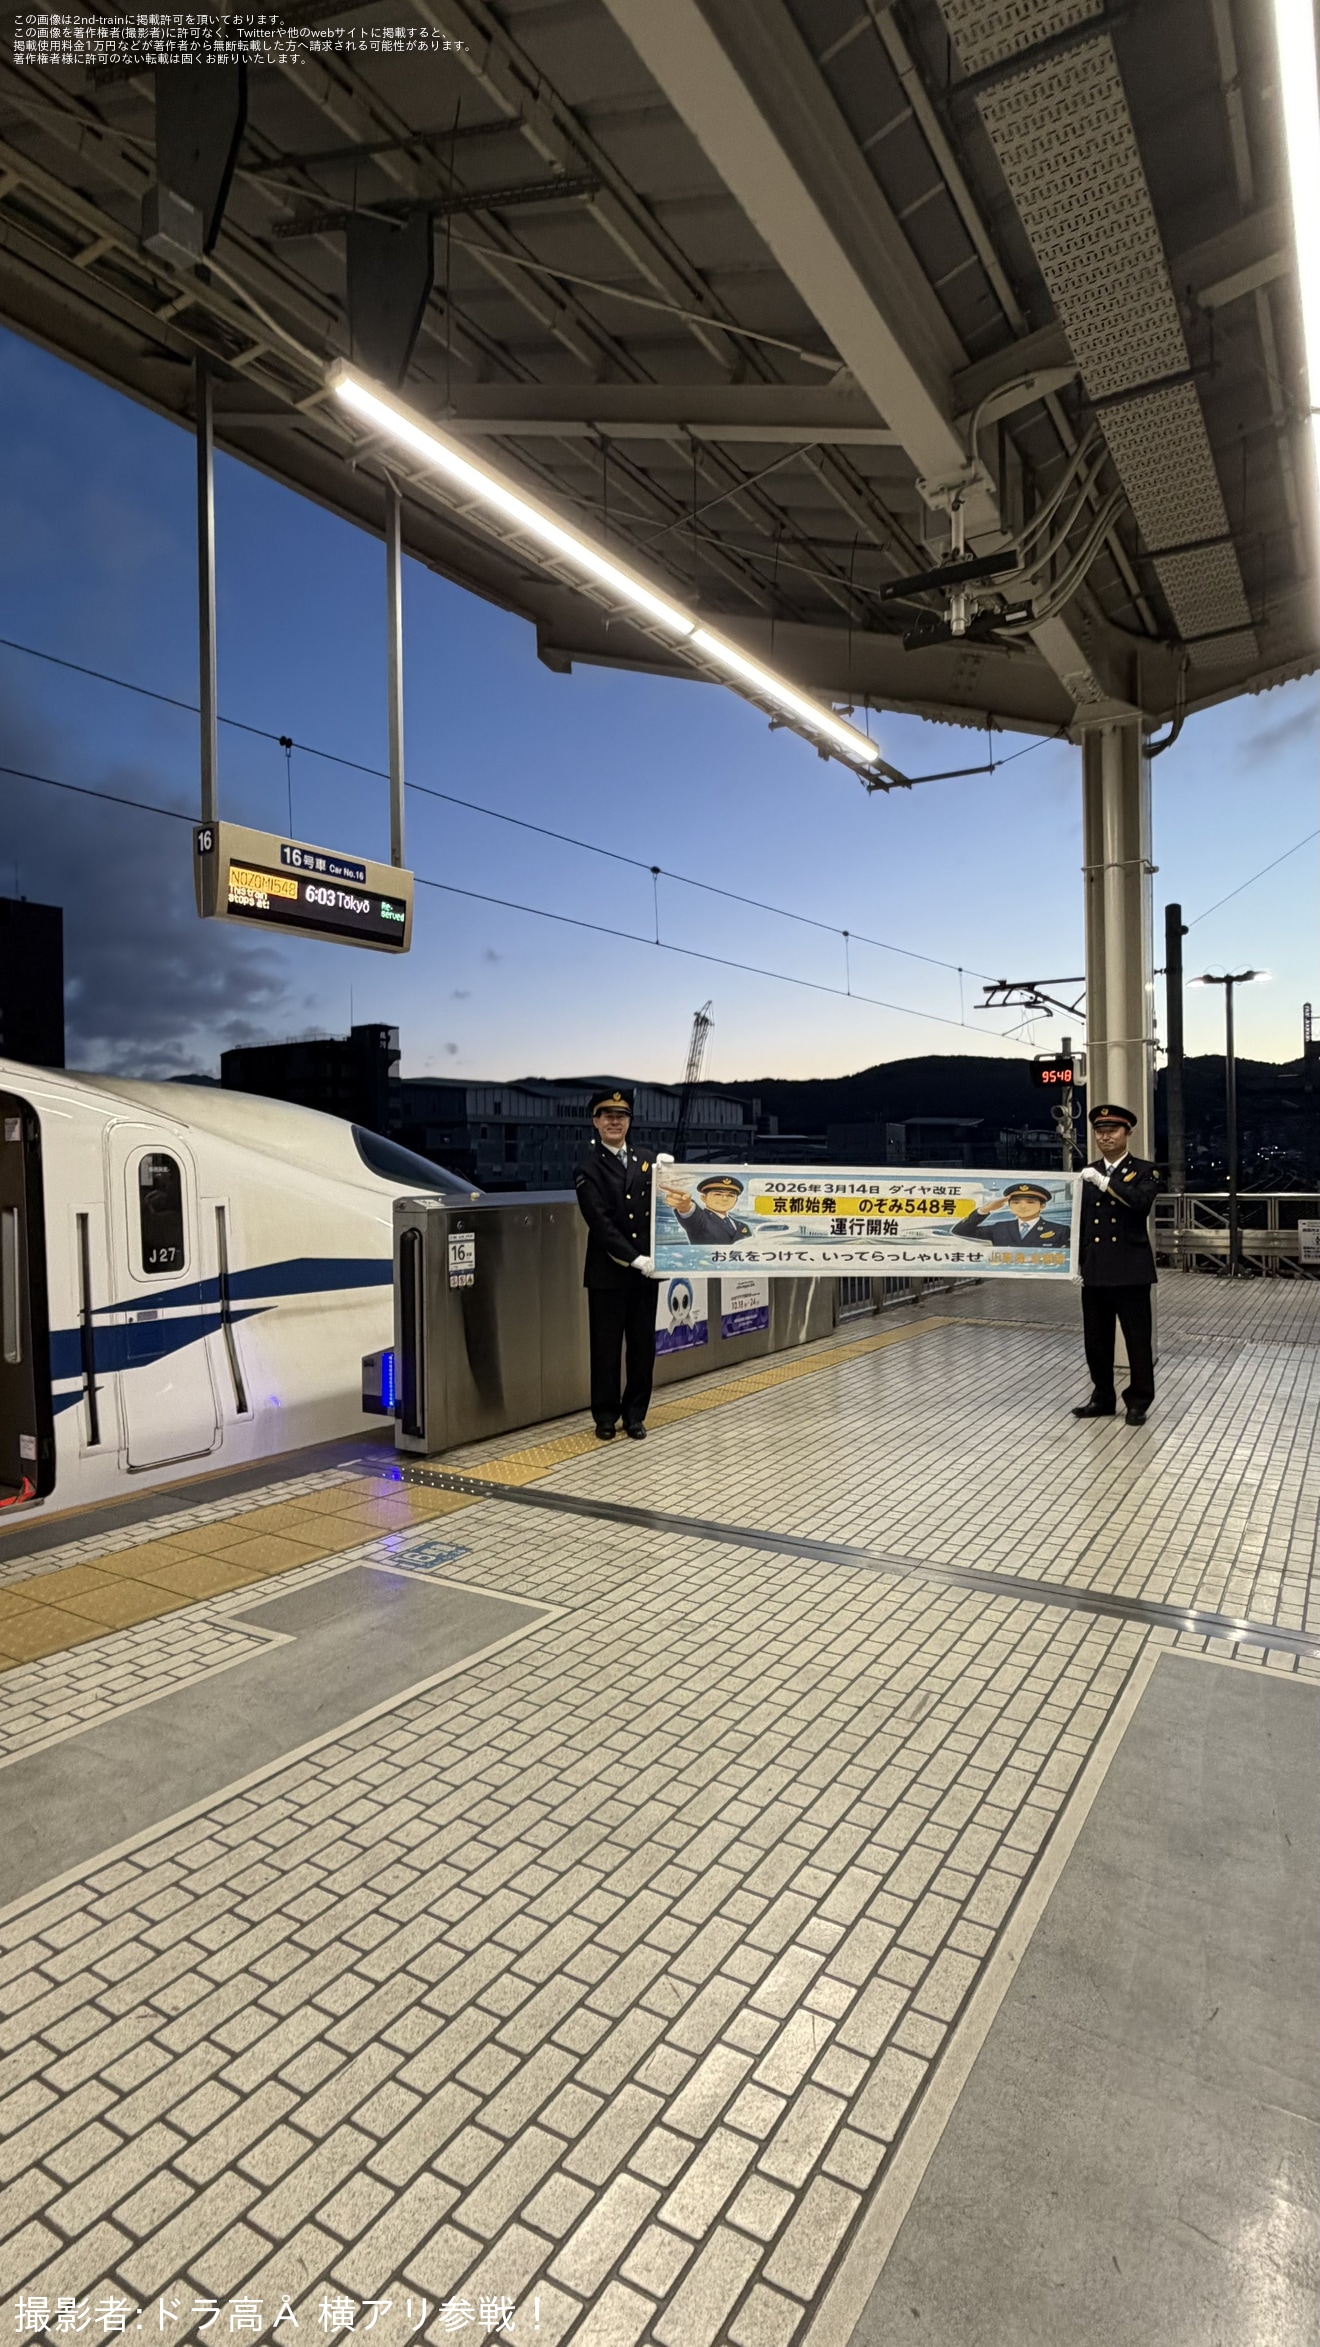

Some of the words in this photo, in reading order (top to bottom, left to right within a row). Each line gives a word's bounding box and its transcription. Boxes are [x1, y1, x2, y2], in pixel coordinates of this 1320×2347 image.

[198, 830, 212, 852] 16
[283, 846, 326, 871] 16号車
[328, 863, 342, 874] Car
[343, 867, 365, 881] No.16
[305, 885, 336, 907] 6:03
[1042, 1069, 1072, 1083] 9548
[764, 1182, 880, 1194] 2026年3月14日
[888, 1185, 962, 1196] ダイヤ改正
[772, 1197, 837, 1214] 京都始発
[858, 1198, 957, 1216] のぞみ548号
[829, 1217, 899, 1236] 運行開始
[451, 1244, 466, 1261] 16
[710, 1249, 984, 1263] お気をつけて、いってらっしゃいませ
